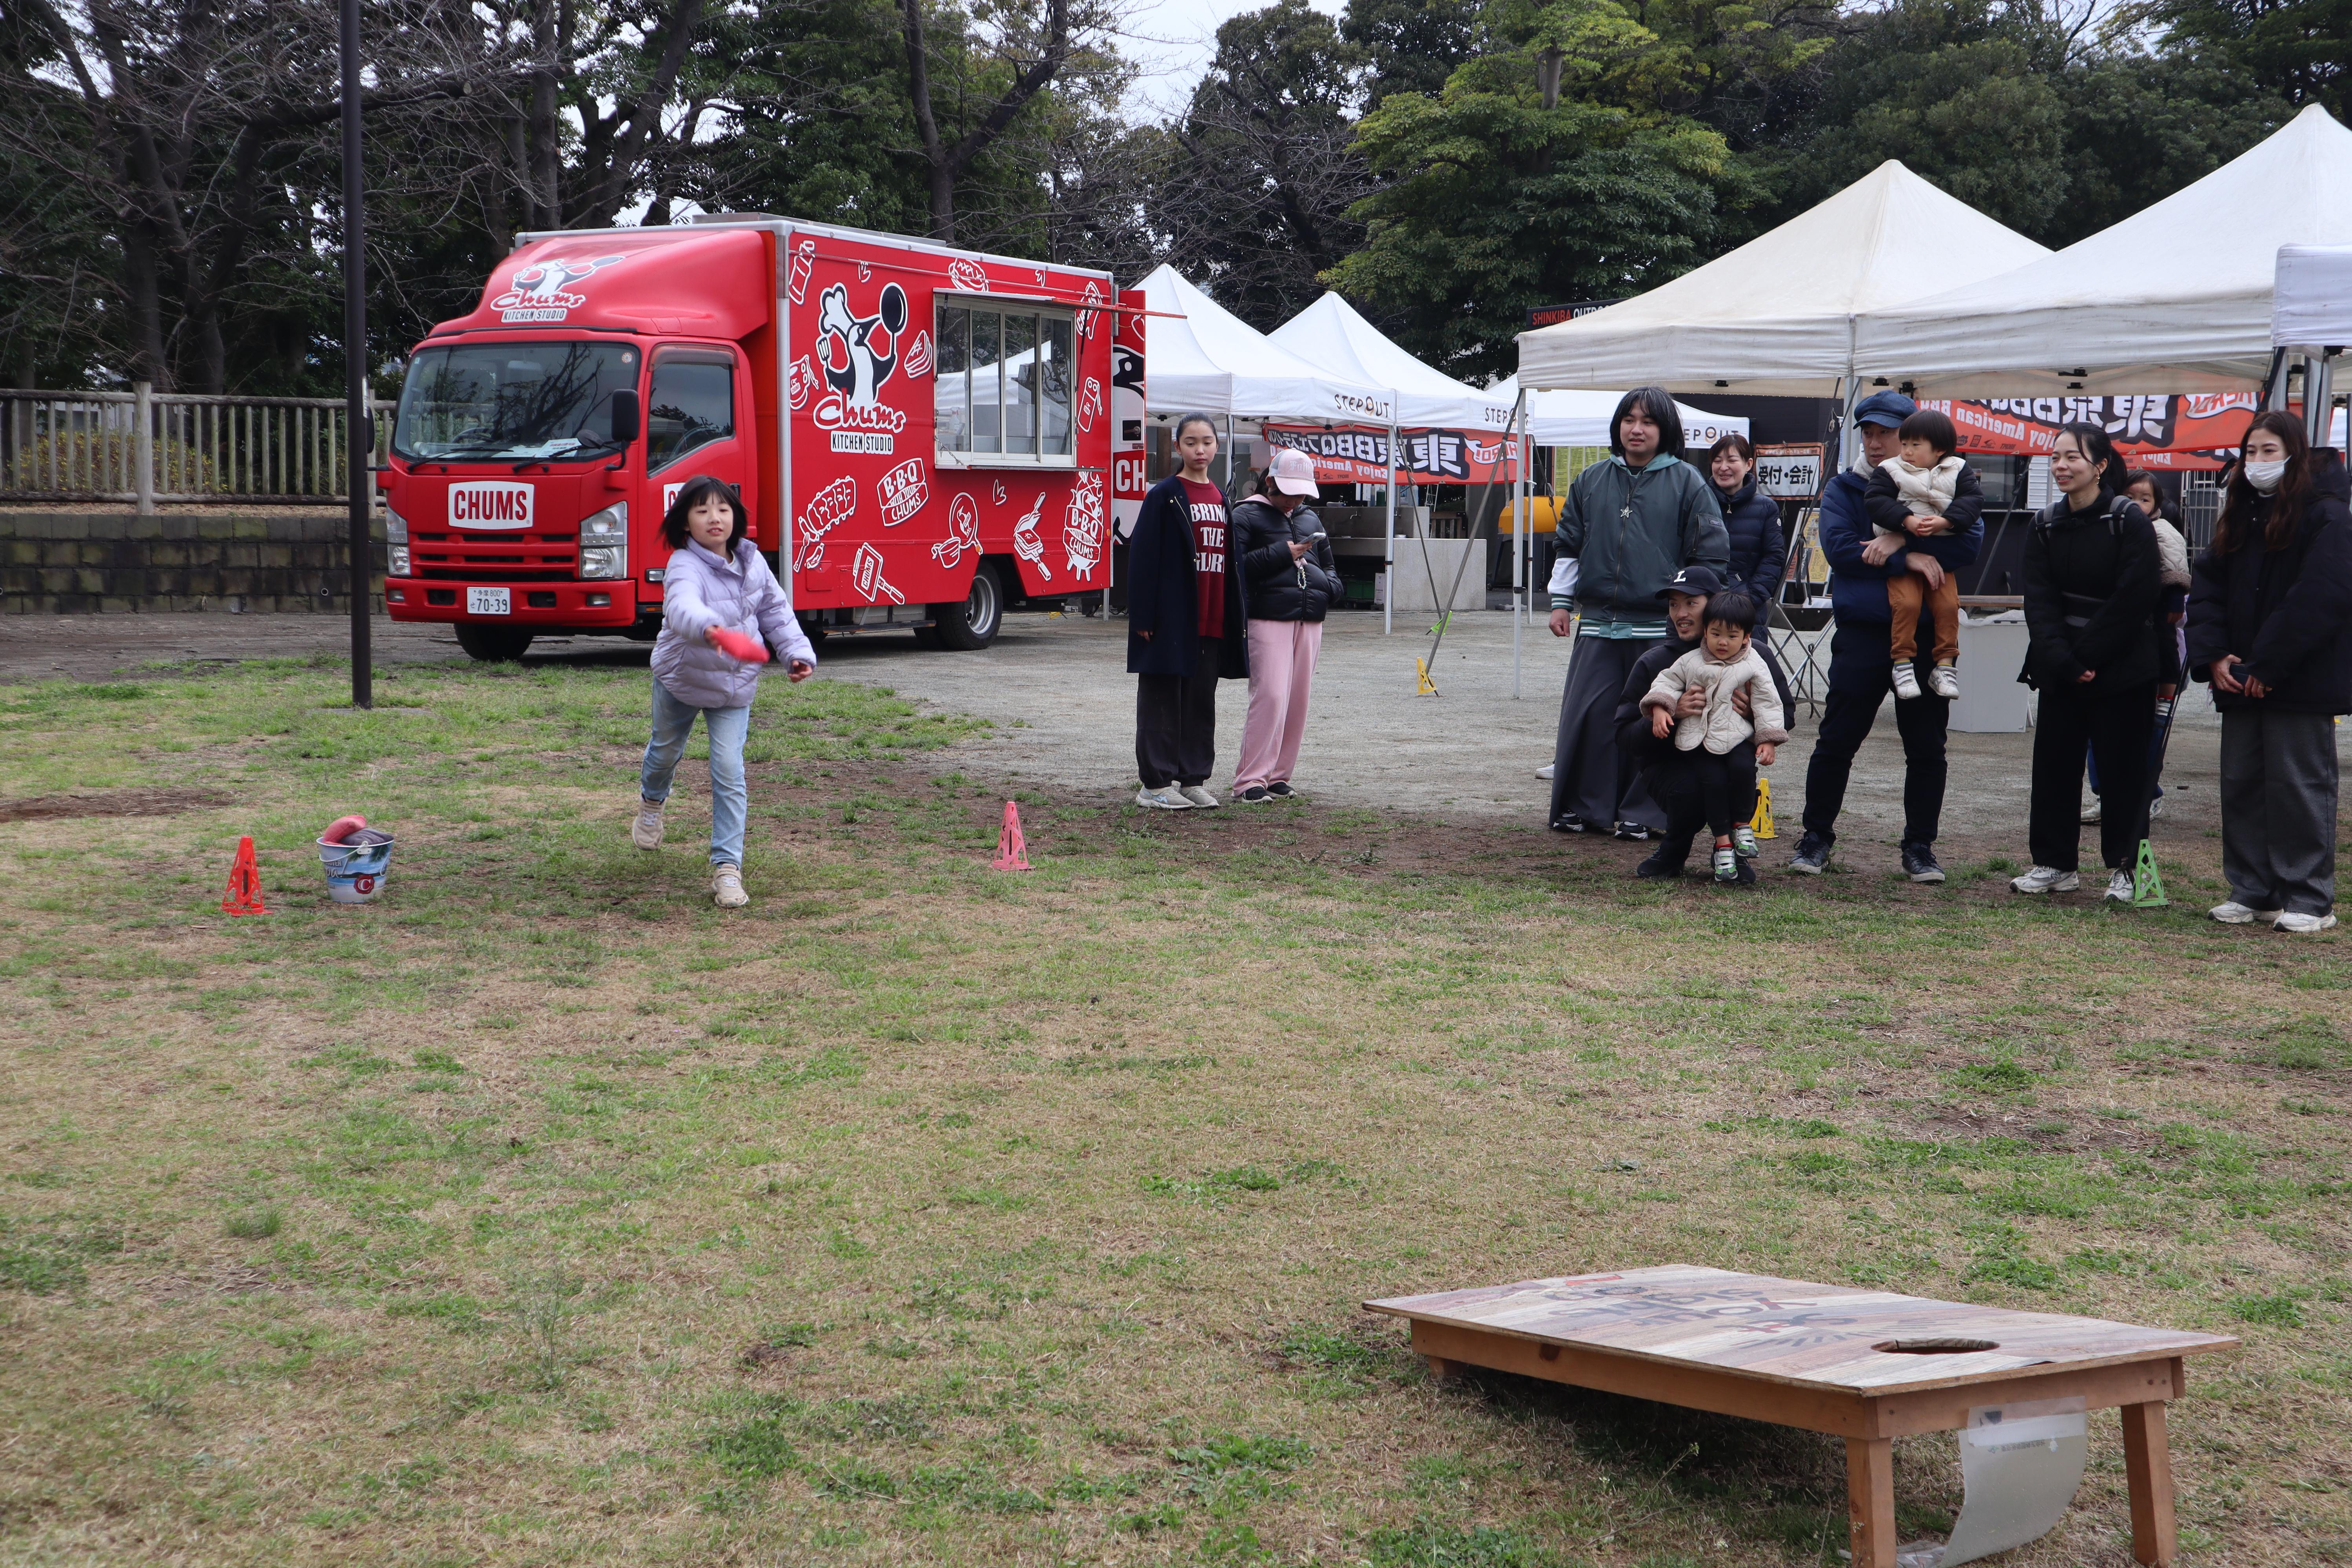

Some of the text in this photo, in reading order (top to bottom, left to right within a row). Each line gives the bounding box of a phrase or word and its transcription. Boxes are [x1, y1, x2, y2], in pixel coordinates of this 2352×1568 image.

[492, 287, 585, 309] Chums
[503, 310, 564, 320] KITCHEN STUDIO
[1532, 309, 1572, 325] SHINKIBA
[815, 387, 905, 431] Chums
[832, 434, 892, 452] KITCHEN STUDIO
[1758, 465, 1813, 485] 受付・会計
[454, 490, 527, 520] CHUMS
[890, 485, 917, 506] WITH YOUR
[891, 492, 921, 520] CHUMS
[1200, 526, 1224, 548] THE
[1069, 537, 1093, 559] CHUMS
[862, 559, 873, 588] CHUMS
[1673, 570, 1686, 583] L
[477, 598, 507, 612] 70-39
[1713, 1313, 1858, 1334] Set
